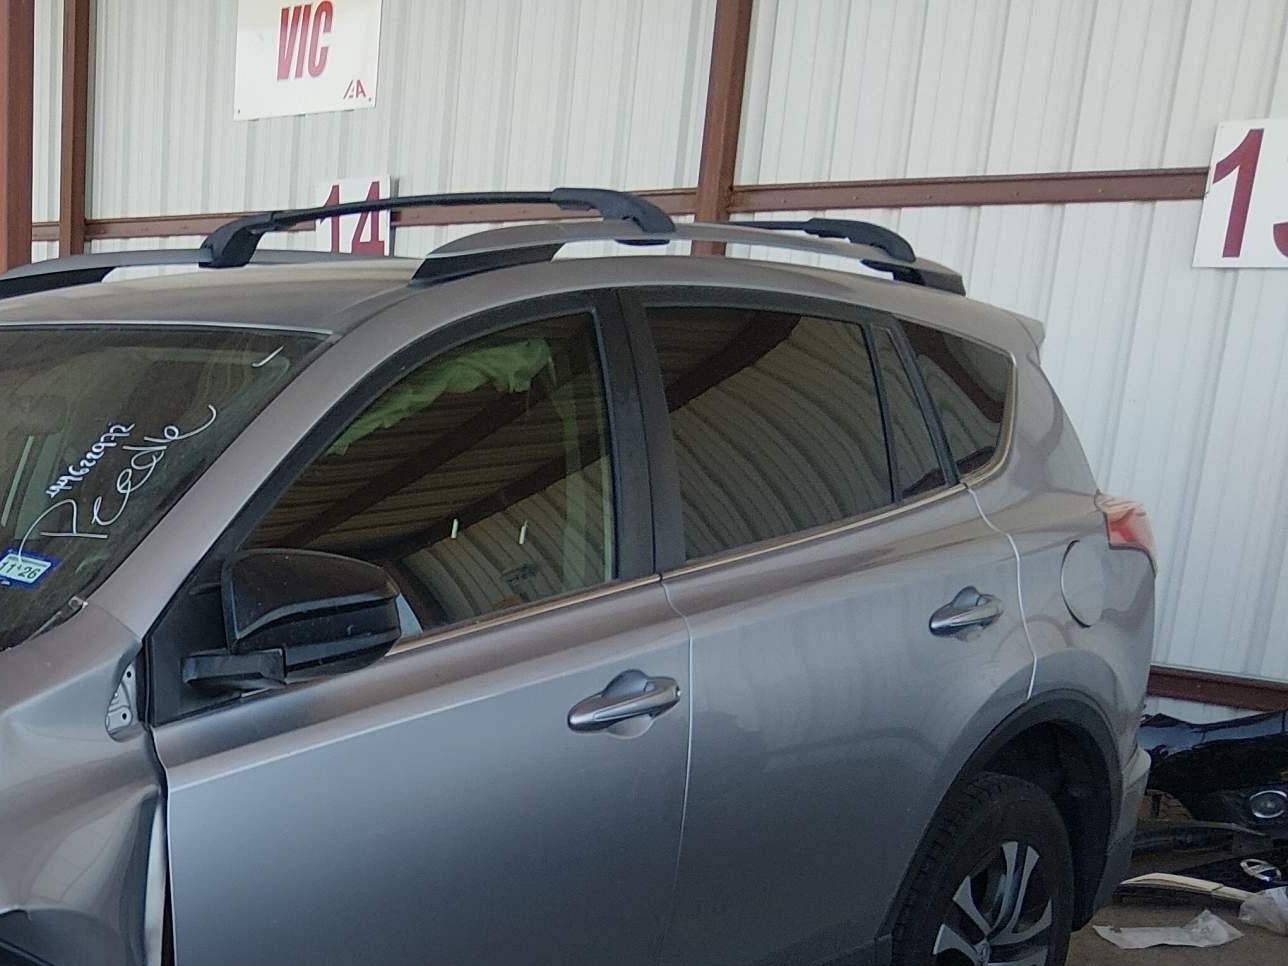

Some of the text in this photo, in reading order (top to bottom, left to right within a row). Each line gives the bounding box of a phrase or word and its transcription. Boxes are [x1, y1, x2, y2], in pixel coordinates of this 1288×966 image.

[276, 0, 333, 81] VIC
[319, 181, 384, 256] 14
[1212, 128, 1288, 259] 1
